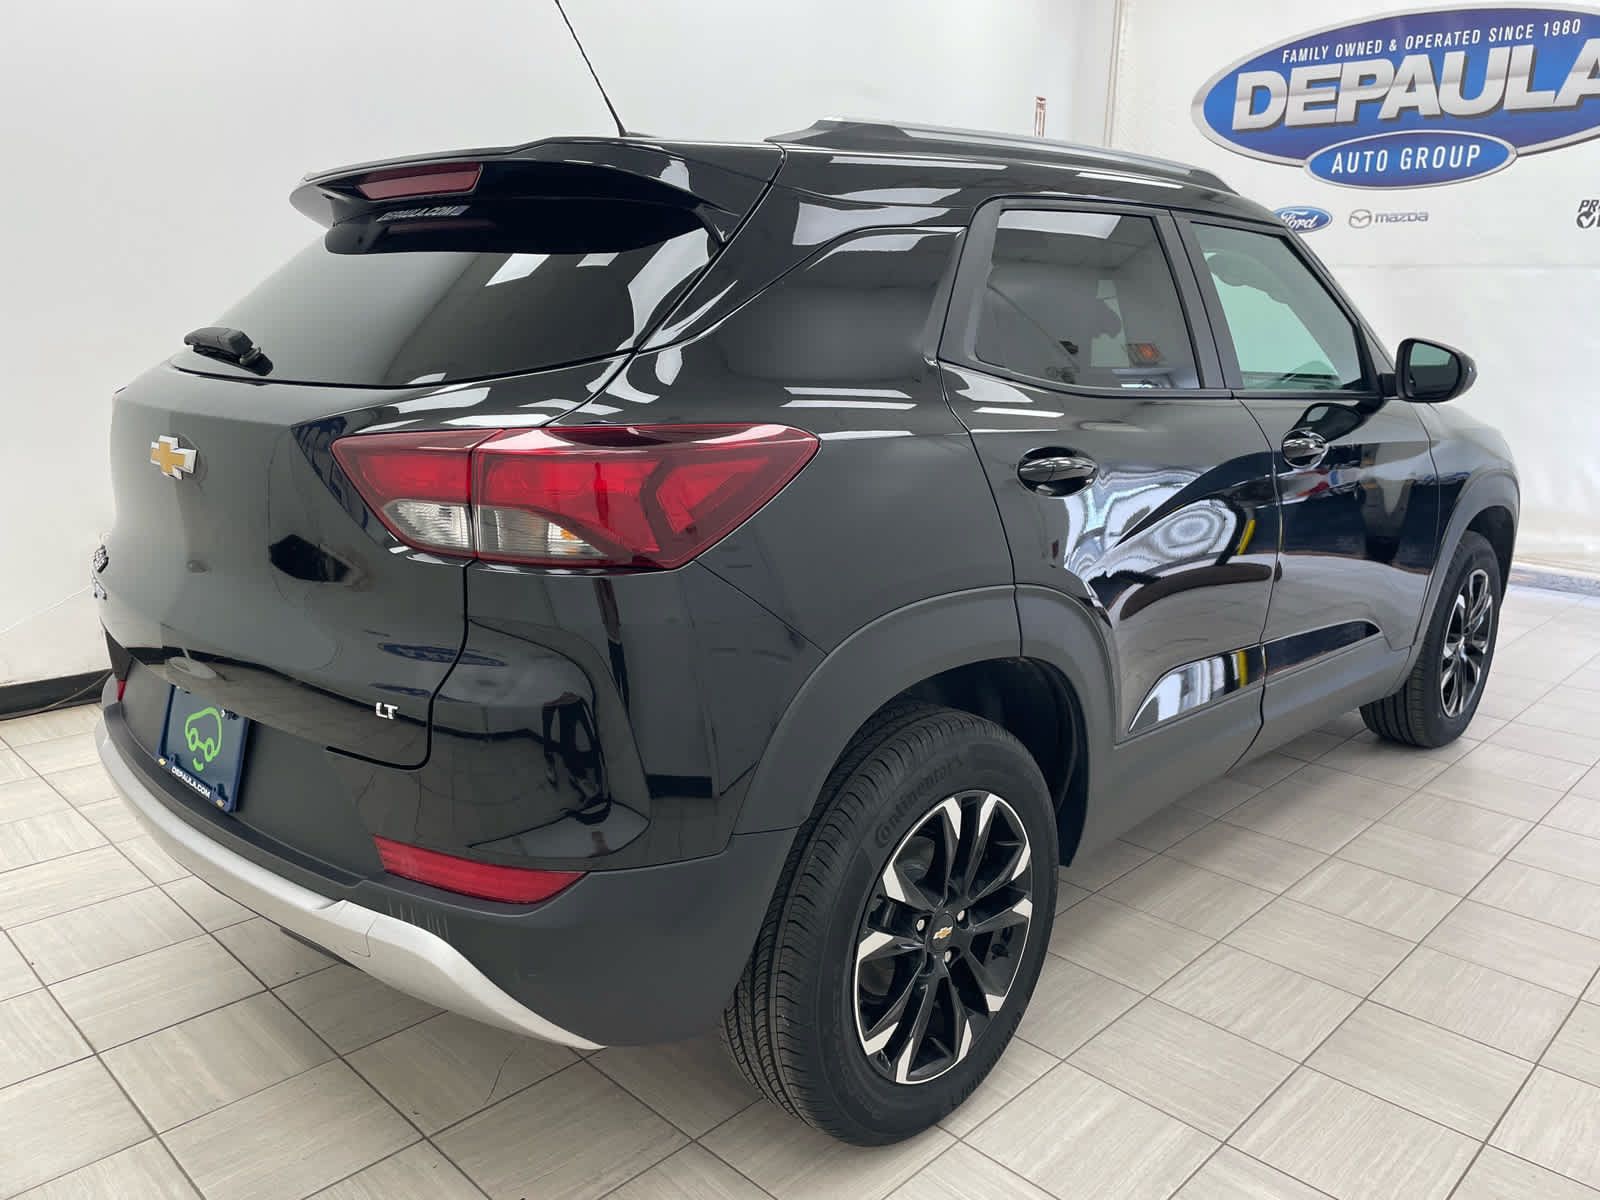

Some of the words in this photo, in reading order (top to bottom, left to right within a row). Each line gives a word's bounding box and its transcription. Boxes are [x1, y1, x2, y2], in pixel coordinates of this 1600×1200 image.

[1282, 45, 1329, 64] FAMILY
[1335, 39, 1382, 58] OWNED
[1388, 39, 1398, 52] &
[1405, 29, 1481, 50] OPERATED
[1488, 23, 1535, 42] SINCE
[1543, 18, 1581, 37] 1980
[1232, 38, 1600, 131] DEPAULA
[1331, 149, 1388, 174] AUTO
[1400, 144, 1481, 170] GROUP
[1280, 209, 1319, 230] Ford
[1374, 211, 1429, 224] mazda
[375, 702, 399, 720] LT
